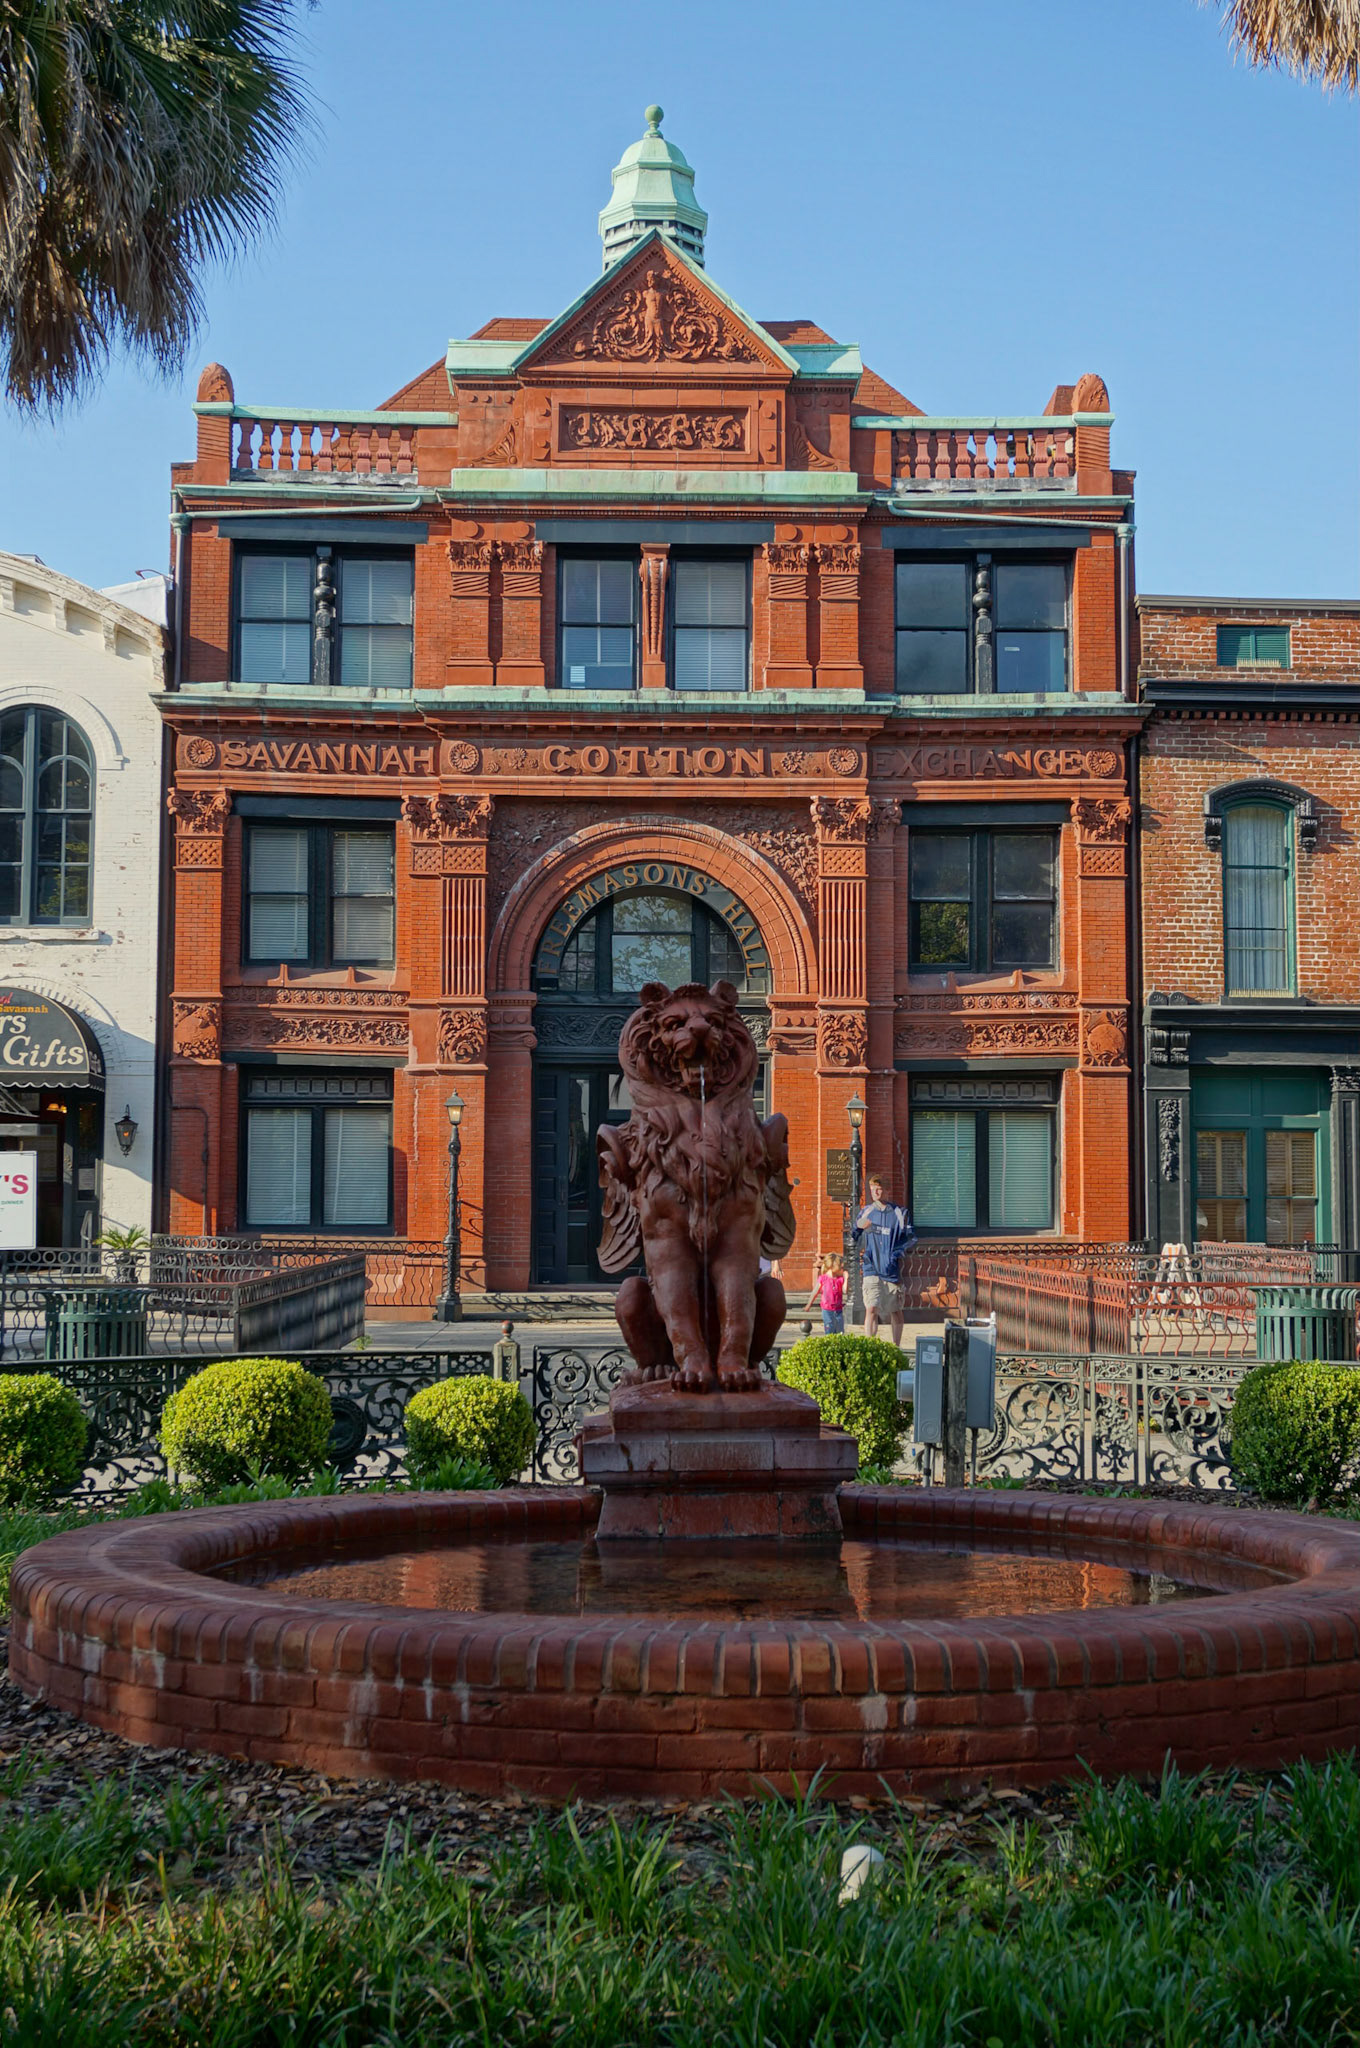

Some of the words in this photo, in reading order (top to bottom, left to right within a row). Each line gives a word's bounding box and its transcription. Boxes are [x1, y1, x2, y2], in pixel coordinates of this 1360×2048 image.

[220, 740, 435, 774] SAVANNAH
[543, 745, 766, 775] COTTON
[871, 749, 1082, 778] EXCHANGE
[719, 899, 767, 978] HALL
[3, 1035, 84, 1067] Gifts
